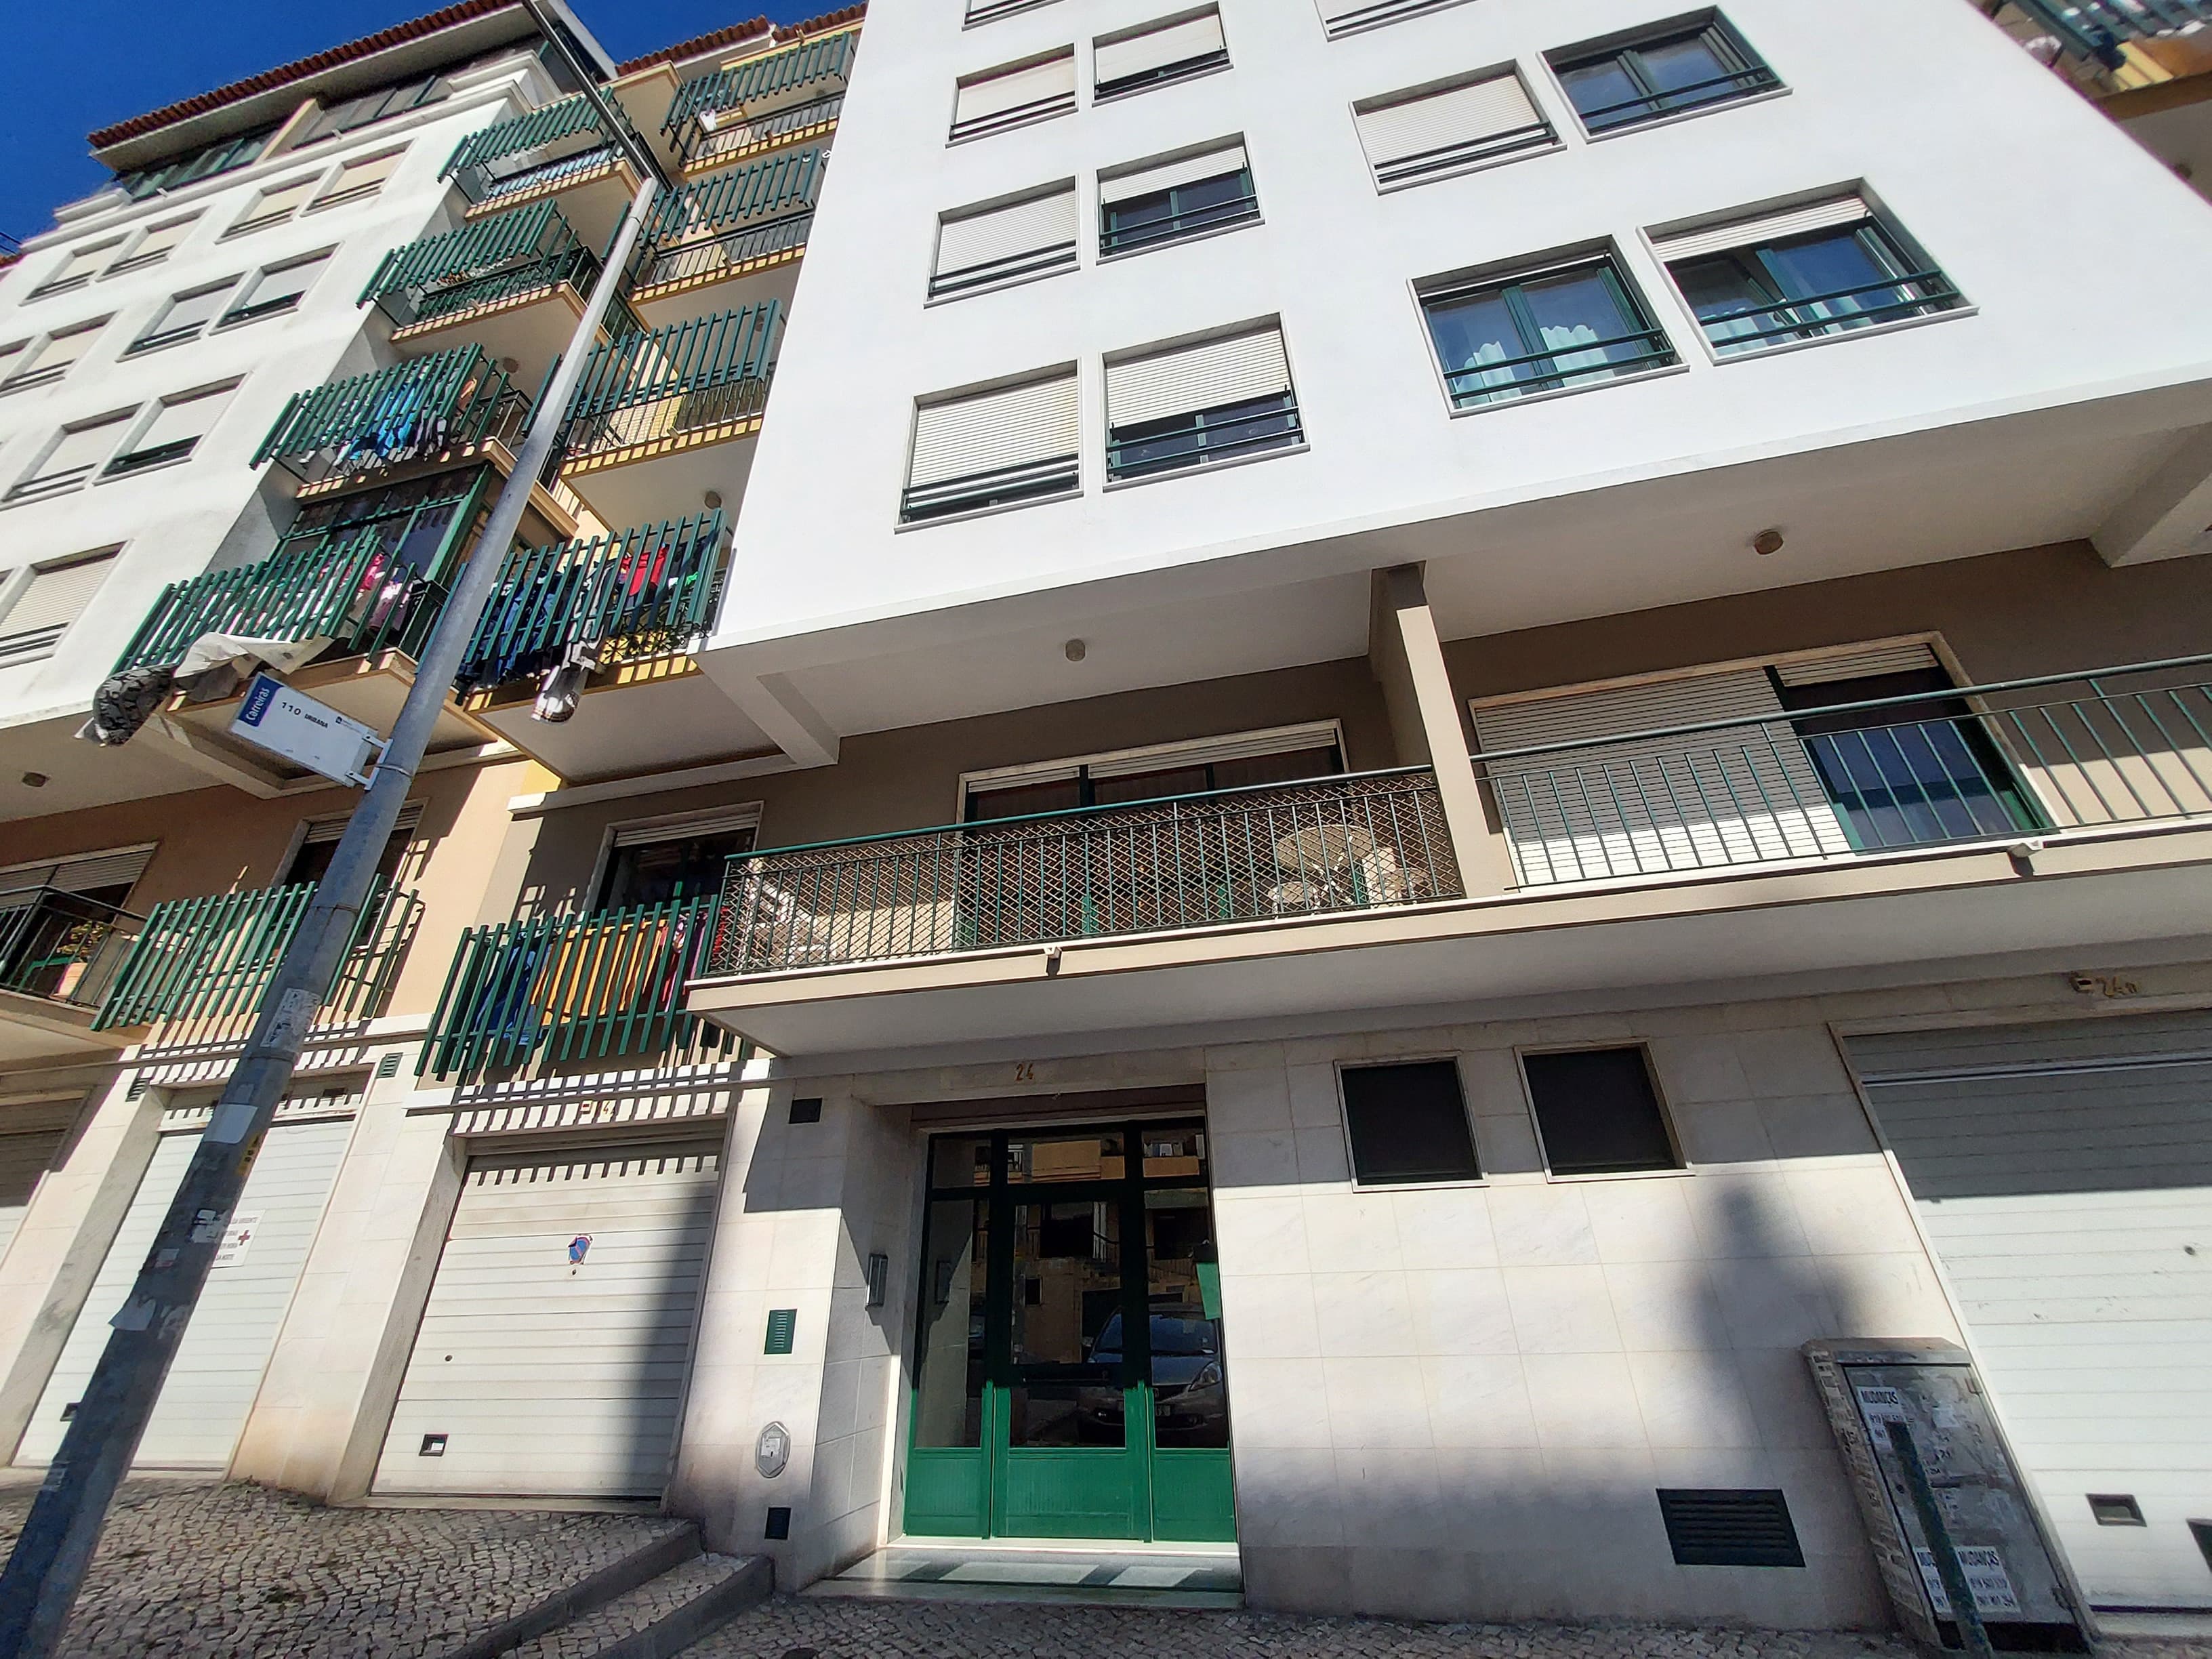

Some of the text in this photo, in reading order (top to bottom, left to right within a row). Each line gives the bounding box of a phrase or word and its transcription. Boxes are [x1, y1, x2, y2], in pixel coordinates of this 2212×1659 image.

[245, 687, 270, 722] Carreiras
[281, 701, 302, 716] 110
[304, 714, 329, 729] URBANA
[1015, 1063, 1034, 1081] 24
